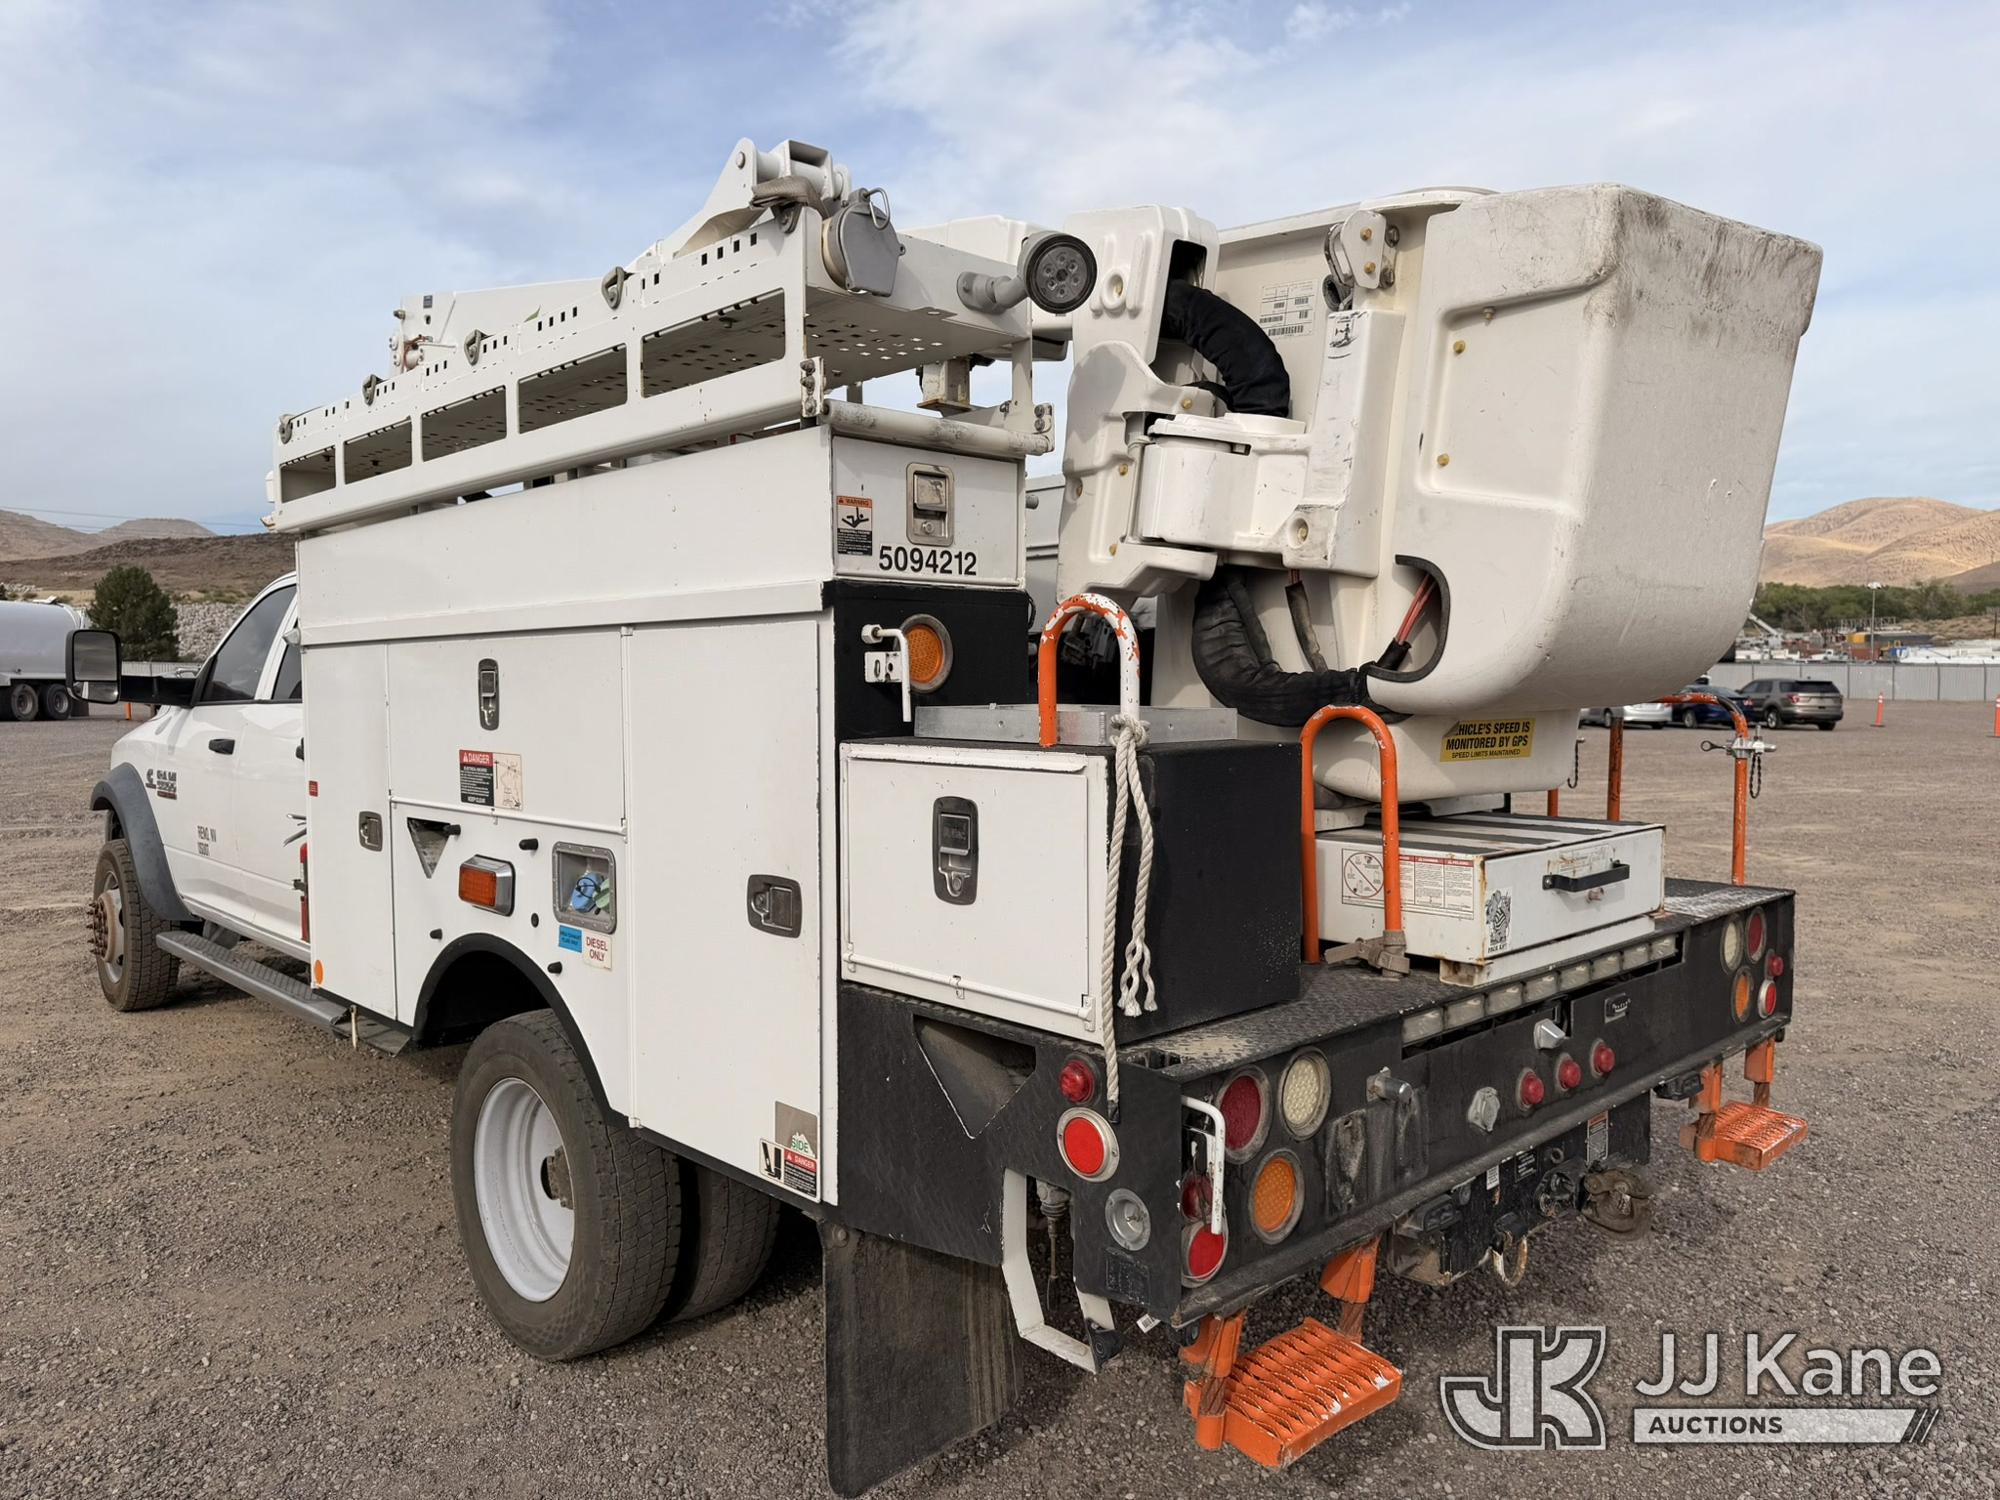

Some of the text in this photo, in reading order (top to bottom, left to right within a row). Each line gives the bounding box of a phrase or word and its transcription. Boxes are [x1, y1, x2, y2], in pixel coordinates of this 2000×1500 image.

[878, 545, 977, 576] 5094212
[1456, 720, 1531, 735] HICLE'S SPEED IS
[1446, 735, 1529, 750] MONITORED BY GPS
[468, 752, 490, 766] DANGER
[1451, 751, 1470, 759] SPEED
[1489, 748, 1521, 757] MAINTAINED
[586, 936, 608, 951] DIESEL
[589, 949, 605, 961] ONLY
[794, 1155, 816, 1169] DANGER
